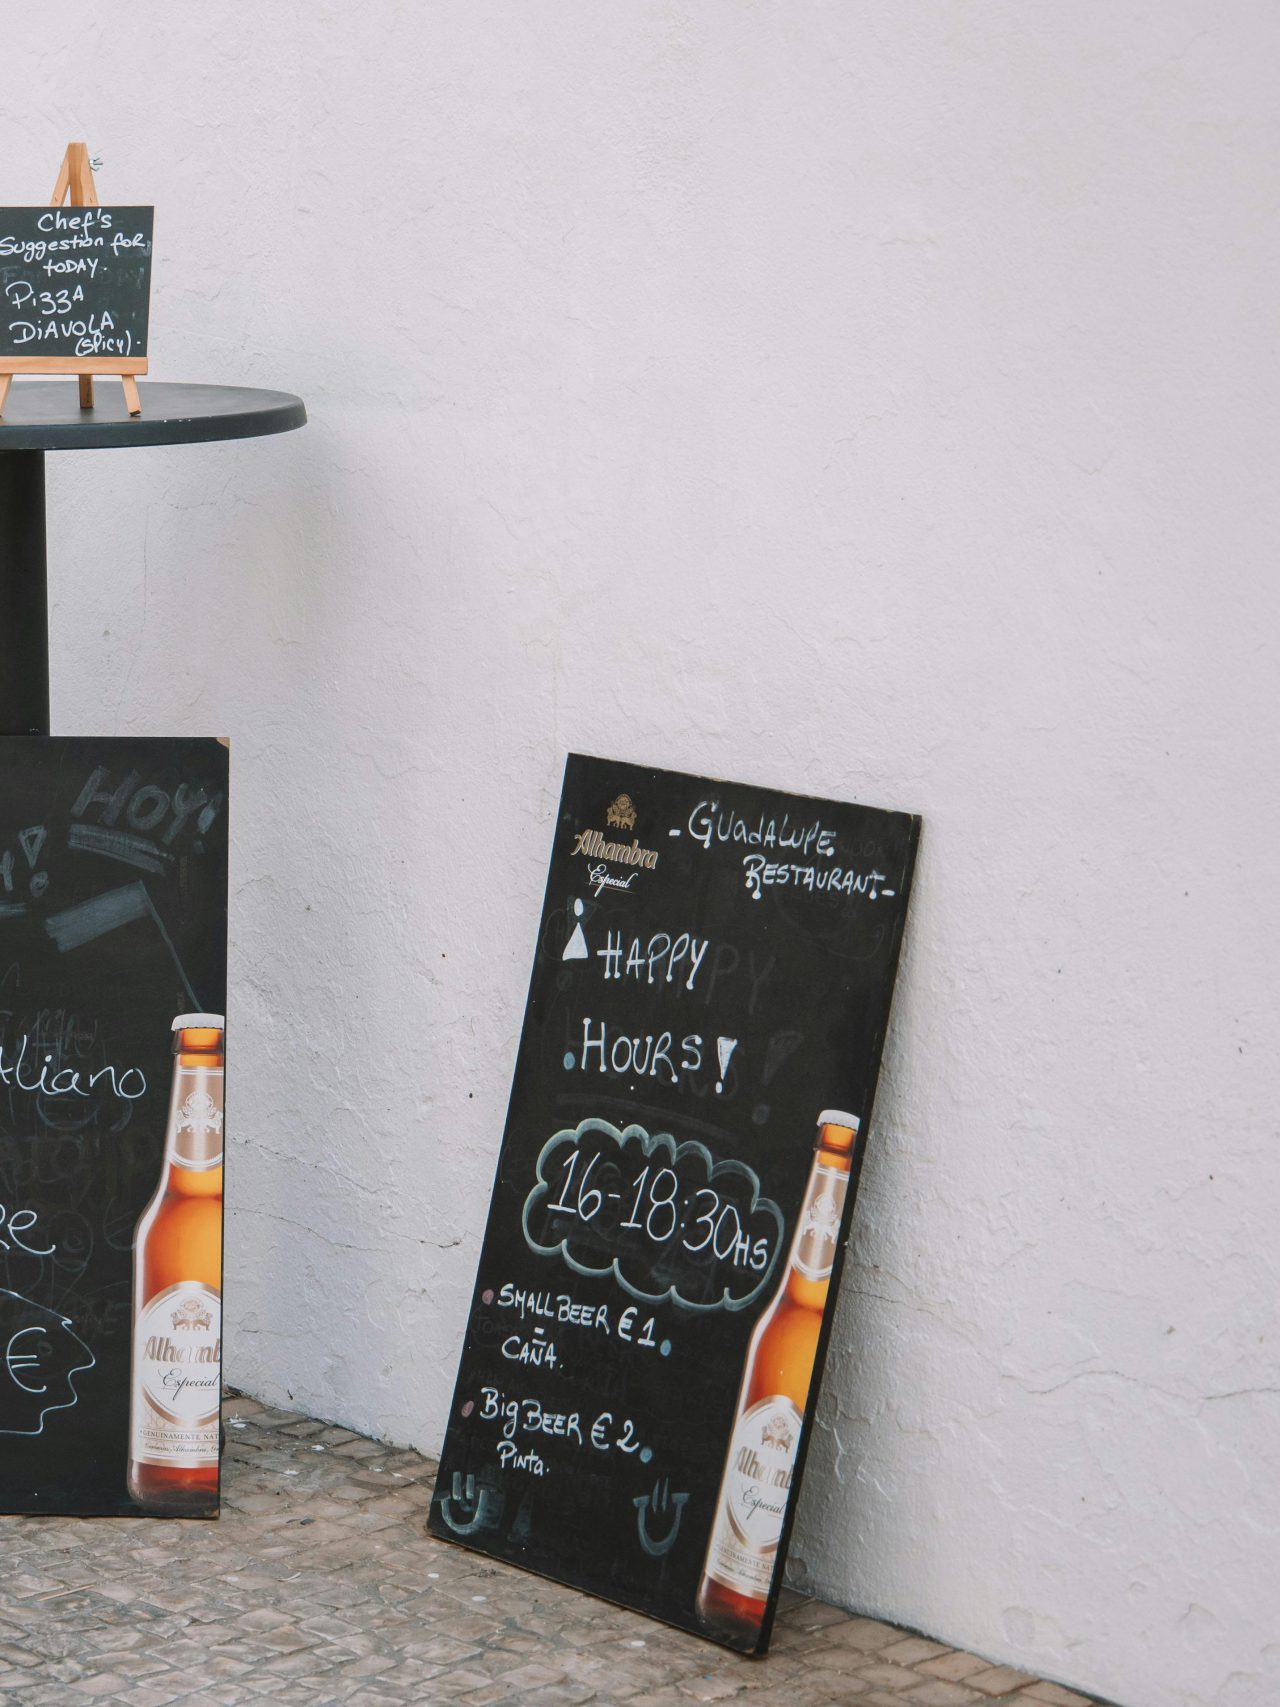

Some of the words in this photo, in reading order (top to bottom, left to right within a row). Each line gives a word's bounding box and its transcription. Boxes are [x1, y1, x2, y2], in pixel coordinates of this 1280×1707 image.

[38, 209, 112, 237] Chef's
[570, 828, 659, 870] Alhambra
[588, 863, 639, 897] Especial
[497, 1283, 554, 1320] SMALL
[556, 1294, 611, 1335] BEER
[158, 1367, 220, 1401] Especial
[522, 1399, 583, 1446] BEER
